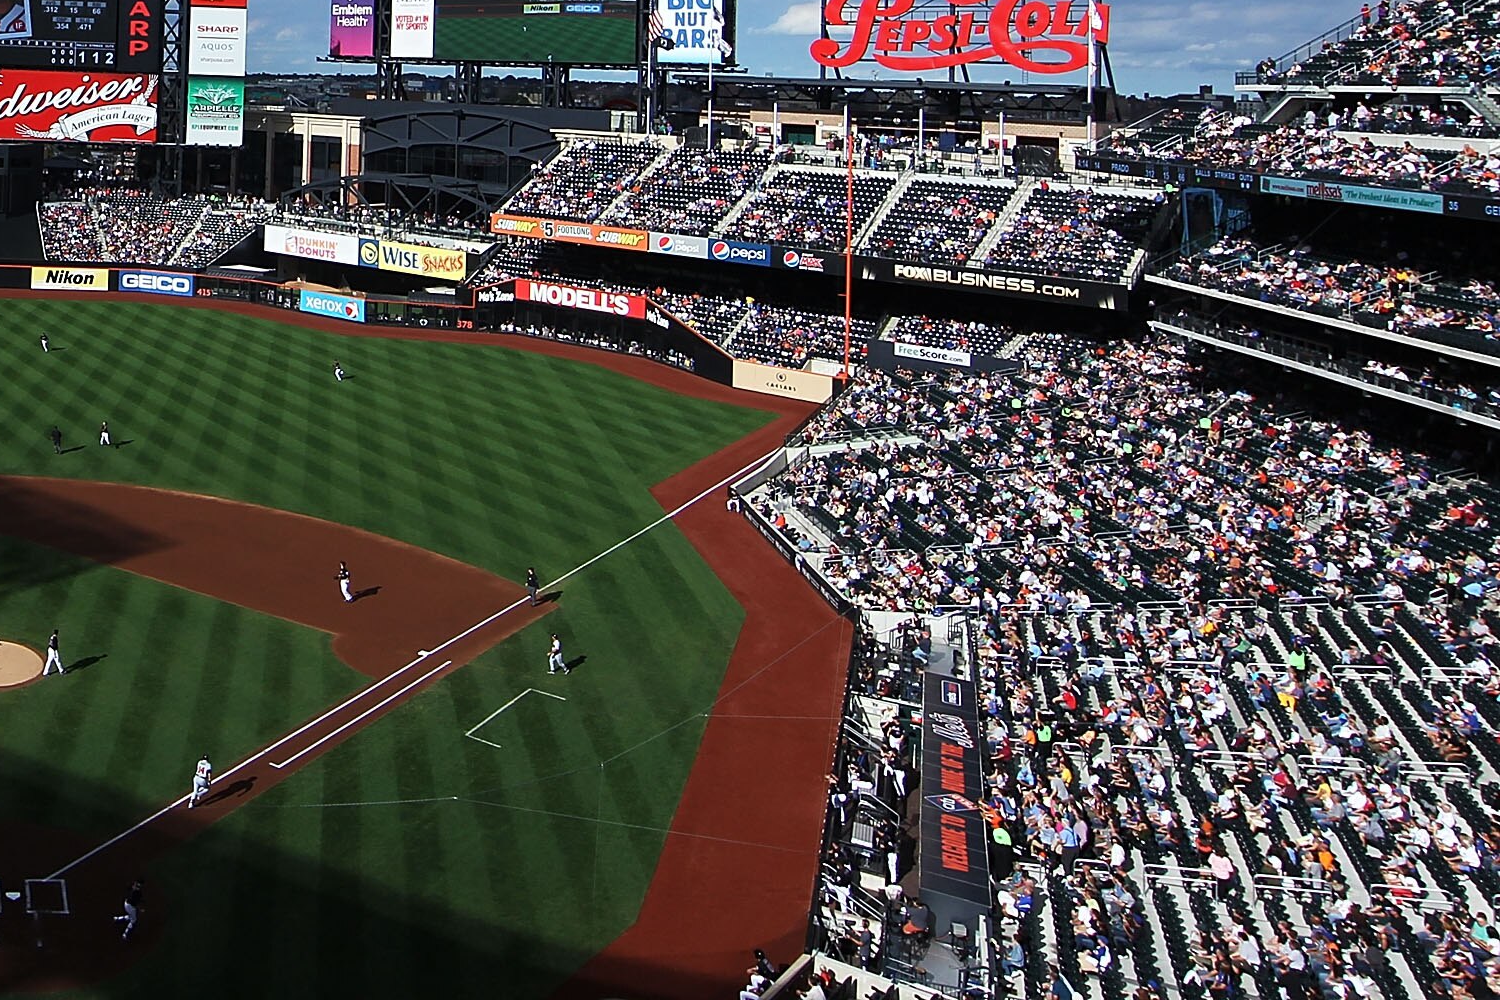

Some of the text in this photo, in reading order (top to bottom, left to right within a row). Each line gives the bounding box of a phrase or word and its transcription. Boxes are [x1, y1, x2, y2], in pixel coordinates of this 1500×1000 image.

[332, 4, 372, 15] Emblem
[566, 4, 600, 13] GEICO
[675, 12, 707, 26] NUT
[54, 22, 91, 31] .354 .471
[197, 25, 238, 33] SHARP
[405, 22, 427, 30] SPORTS
[201, 43, 233, 51] AQUOS
[79, 51, 114, 64] 1 1 2
[71, 111, 152, 133] American Lager
[1111, 163, 1129, 173] PRADO
[1195, 169, 1253, 181] BALLS STRIKES OUTS
[1306, 183, 1343, 200] melissa's
[1359, 191, 1383, 202] Freshest
[1383, 194, 1401, 203] Ideas
[1448, 200, 1459, 211] 35
[494, 219, 538, 233] SUBWAY
[558, 224, 591, 236] FOOTLONG
[299, 238, 338, 251] DUNKIN'
[596, 230, 645, 246] SUBWAY
[298, 246, 336, 259] DONUTS
[675, 243, 700, 253] pepsi
[730, 246, 766, 261] pepsi
[382, 245, 464, 273] WISE SNACKS
[46, 269, 95, 285] Nikon
[121, 274, 190, 293] GEICO
[895, 265, 1080, 299] FOX BUSINESS.COM
[196, 288, 211, 297] 415
[498, 291, 515, 302] Zone
[306, 296, 343, 314] xerox
[530, 283, 630, 316] MODELL'S
[457, 320, 473, 329] 378
[766, 381, 797, 392] CAESARS
[929, 712, 974, 749] Mets
[941, 742, 963, 758] THE
[941, 756, 964, 769] OF
[941, 768, 965, 795] HOME
[941, 813, 969, 873] WELCOME TO
